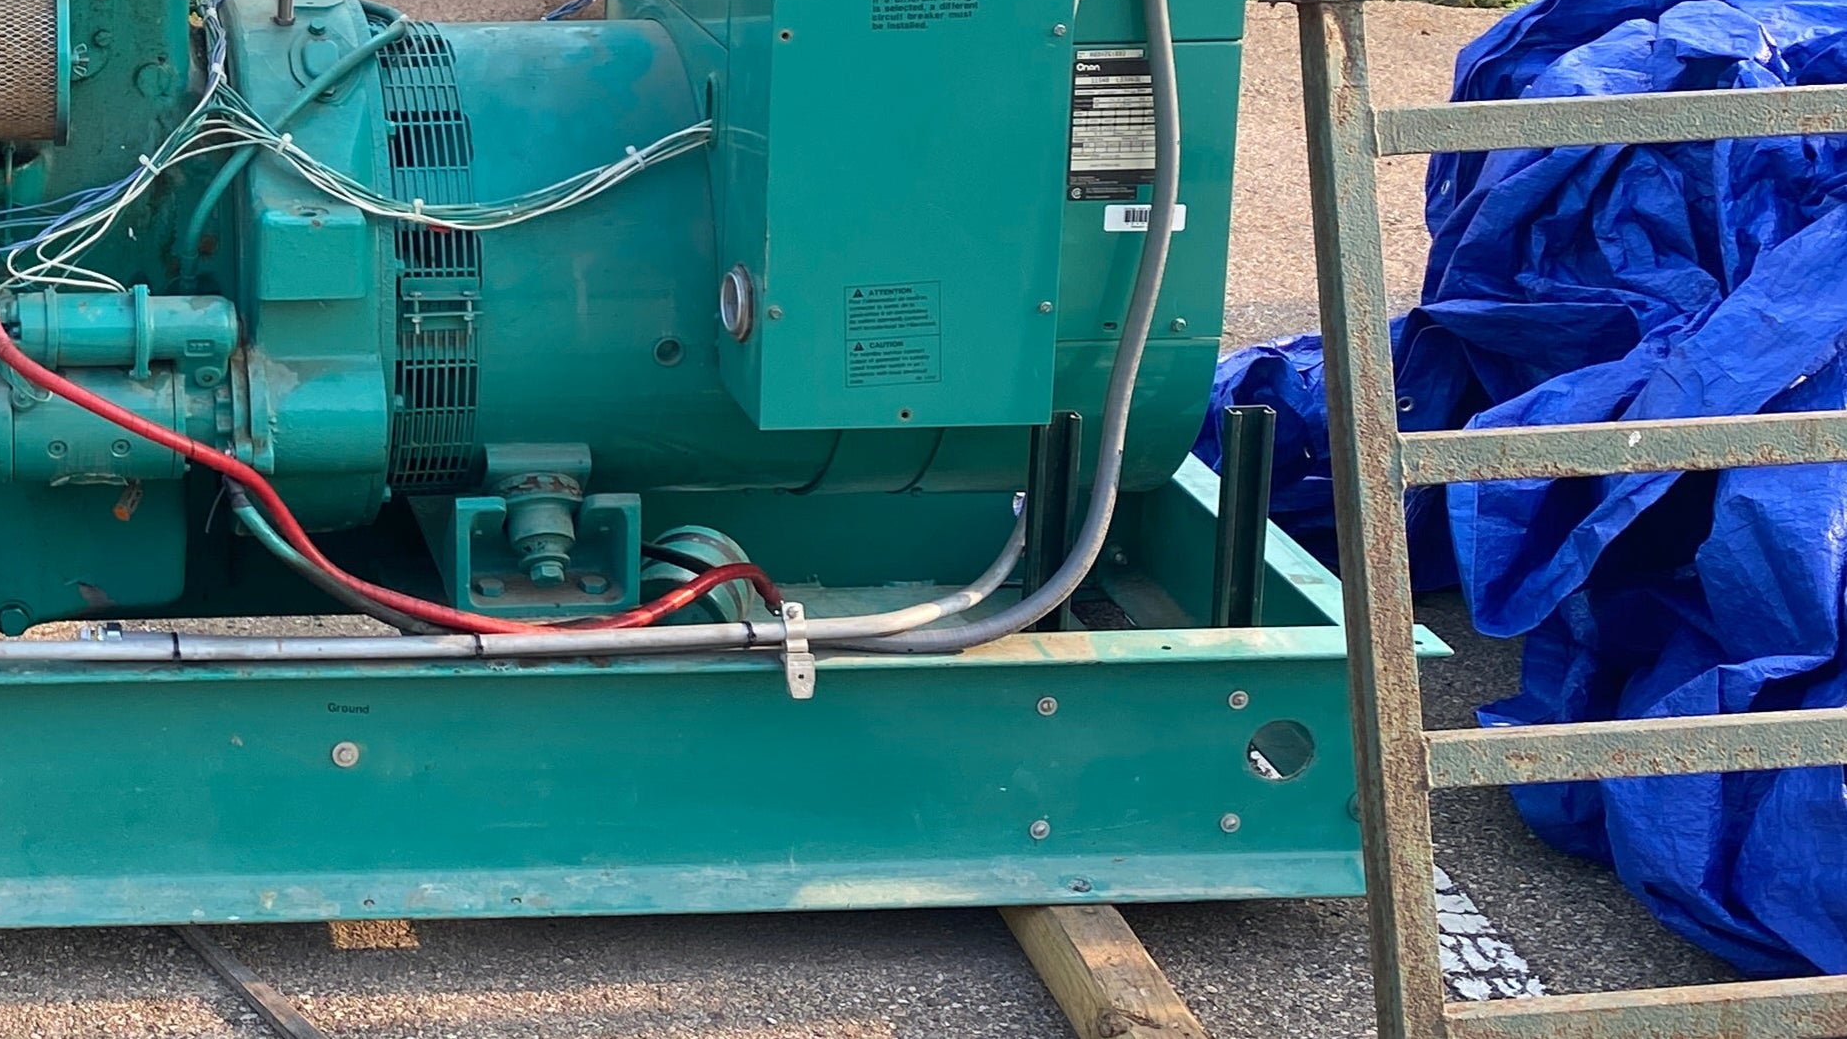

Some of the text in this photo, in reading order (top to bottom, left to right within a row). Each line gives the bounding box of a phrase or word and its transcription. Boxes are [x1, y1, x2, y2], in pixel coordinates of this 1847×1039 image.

[872, 5, 881, 13] is
[939, 1, 979, 10] different
[872, 11, 973, 21] circuit breaker must
[872, 21, 884, 30] be
[1076, 63, 1101, 72] Onan
[869, 287, 912, 296] ATTENTION
[868, 341, 904, 349] CAUTION
[327, 702, 370, 714] Ground
